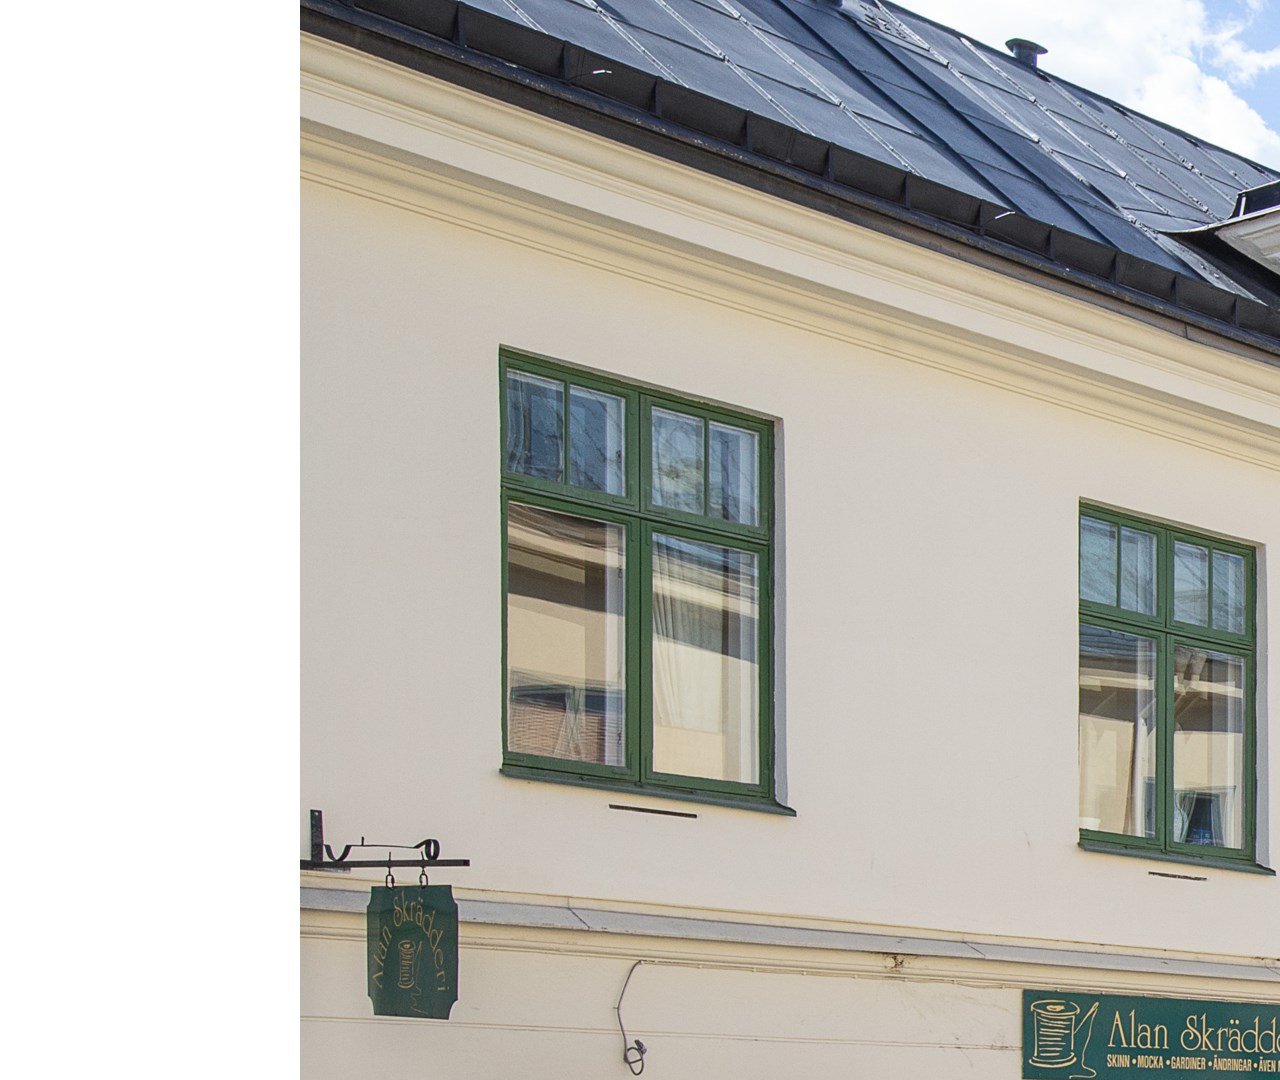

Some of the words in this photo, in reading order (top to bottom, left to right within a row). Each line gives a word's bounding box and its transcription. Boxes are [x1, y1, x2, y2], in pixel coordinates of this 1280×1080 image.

[373, 925, 392, 988] Alan
[393, 889, 450, 992] Skrädderi
[1108, 1009, 1169, 1049] Alan
[1107, 1054, 1130, 1068] SKINN
[1137, 1056, 1164, 1069] MOCKA
[1171, 1057, 1206, 1070] GARDINER
[1213, 1054, 1252, 1072] ÄNDRINGAR
[1258, 1057, 1276, 1072] ÄVEN
